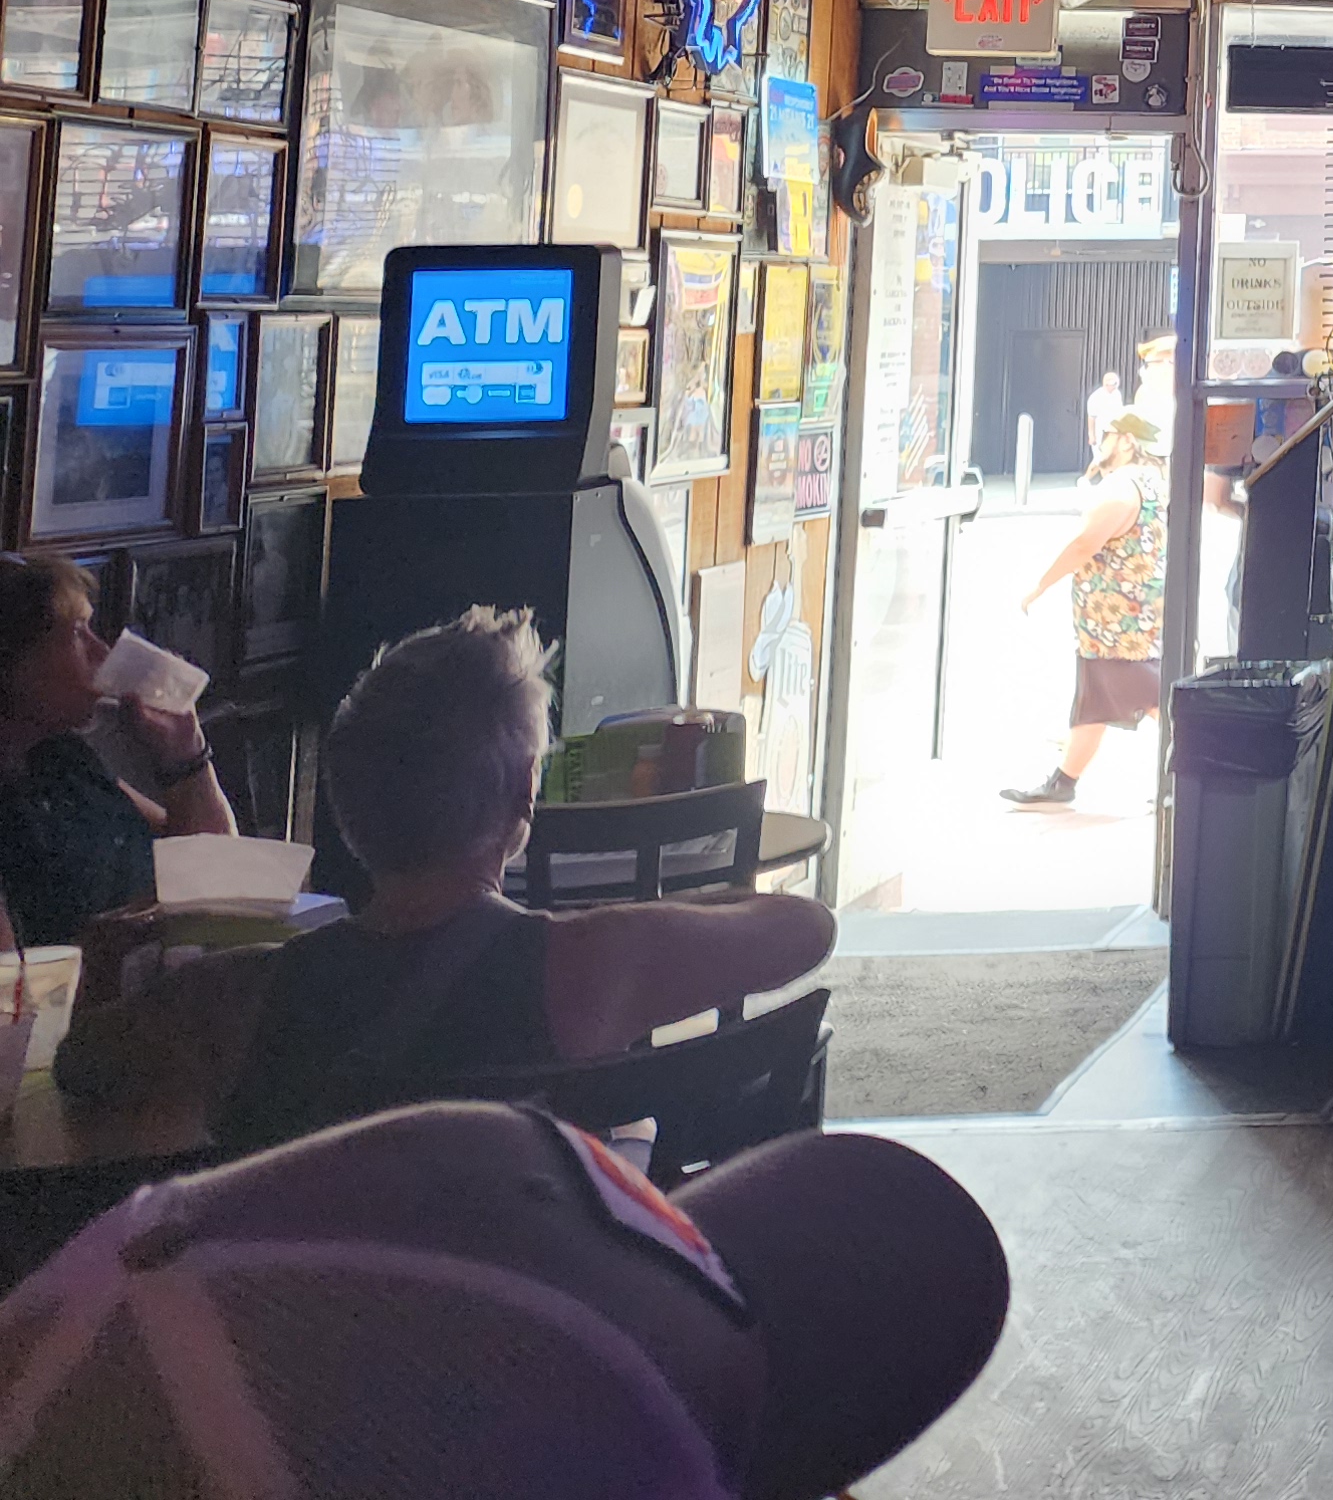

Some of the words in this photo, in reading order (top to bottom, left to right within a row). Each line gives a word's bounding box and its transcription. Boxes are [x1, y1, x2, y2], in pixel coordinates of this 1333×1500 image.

[1248, 257, 1267, 268] NO
[1231, 276, 1282, 290] DRINKS
[1226, 299, 1285, 312] OUTSIDE
[417, 297, 565, 346] ATM
[799, 438, 812, 467] NO
[797, 471, 830, 509] MOKIN
